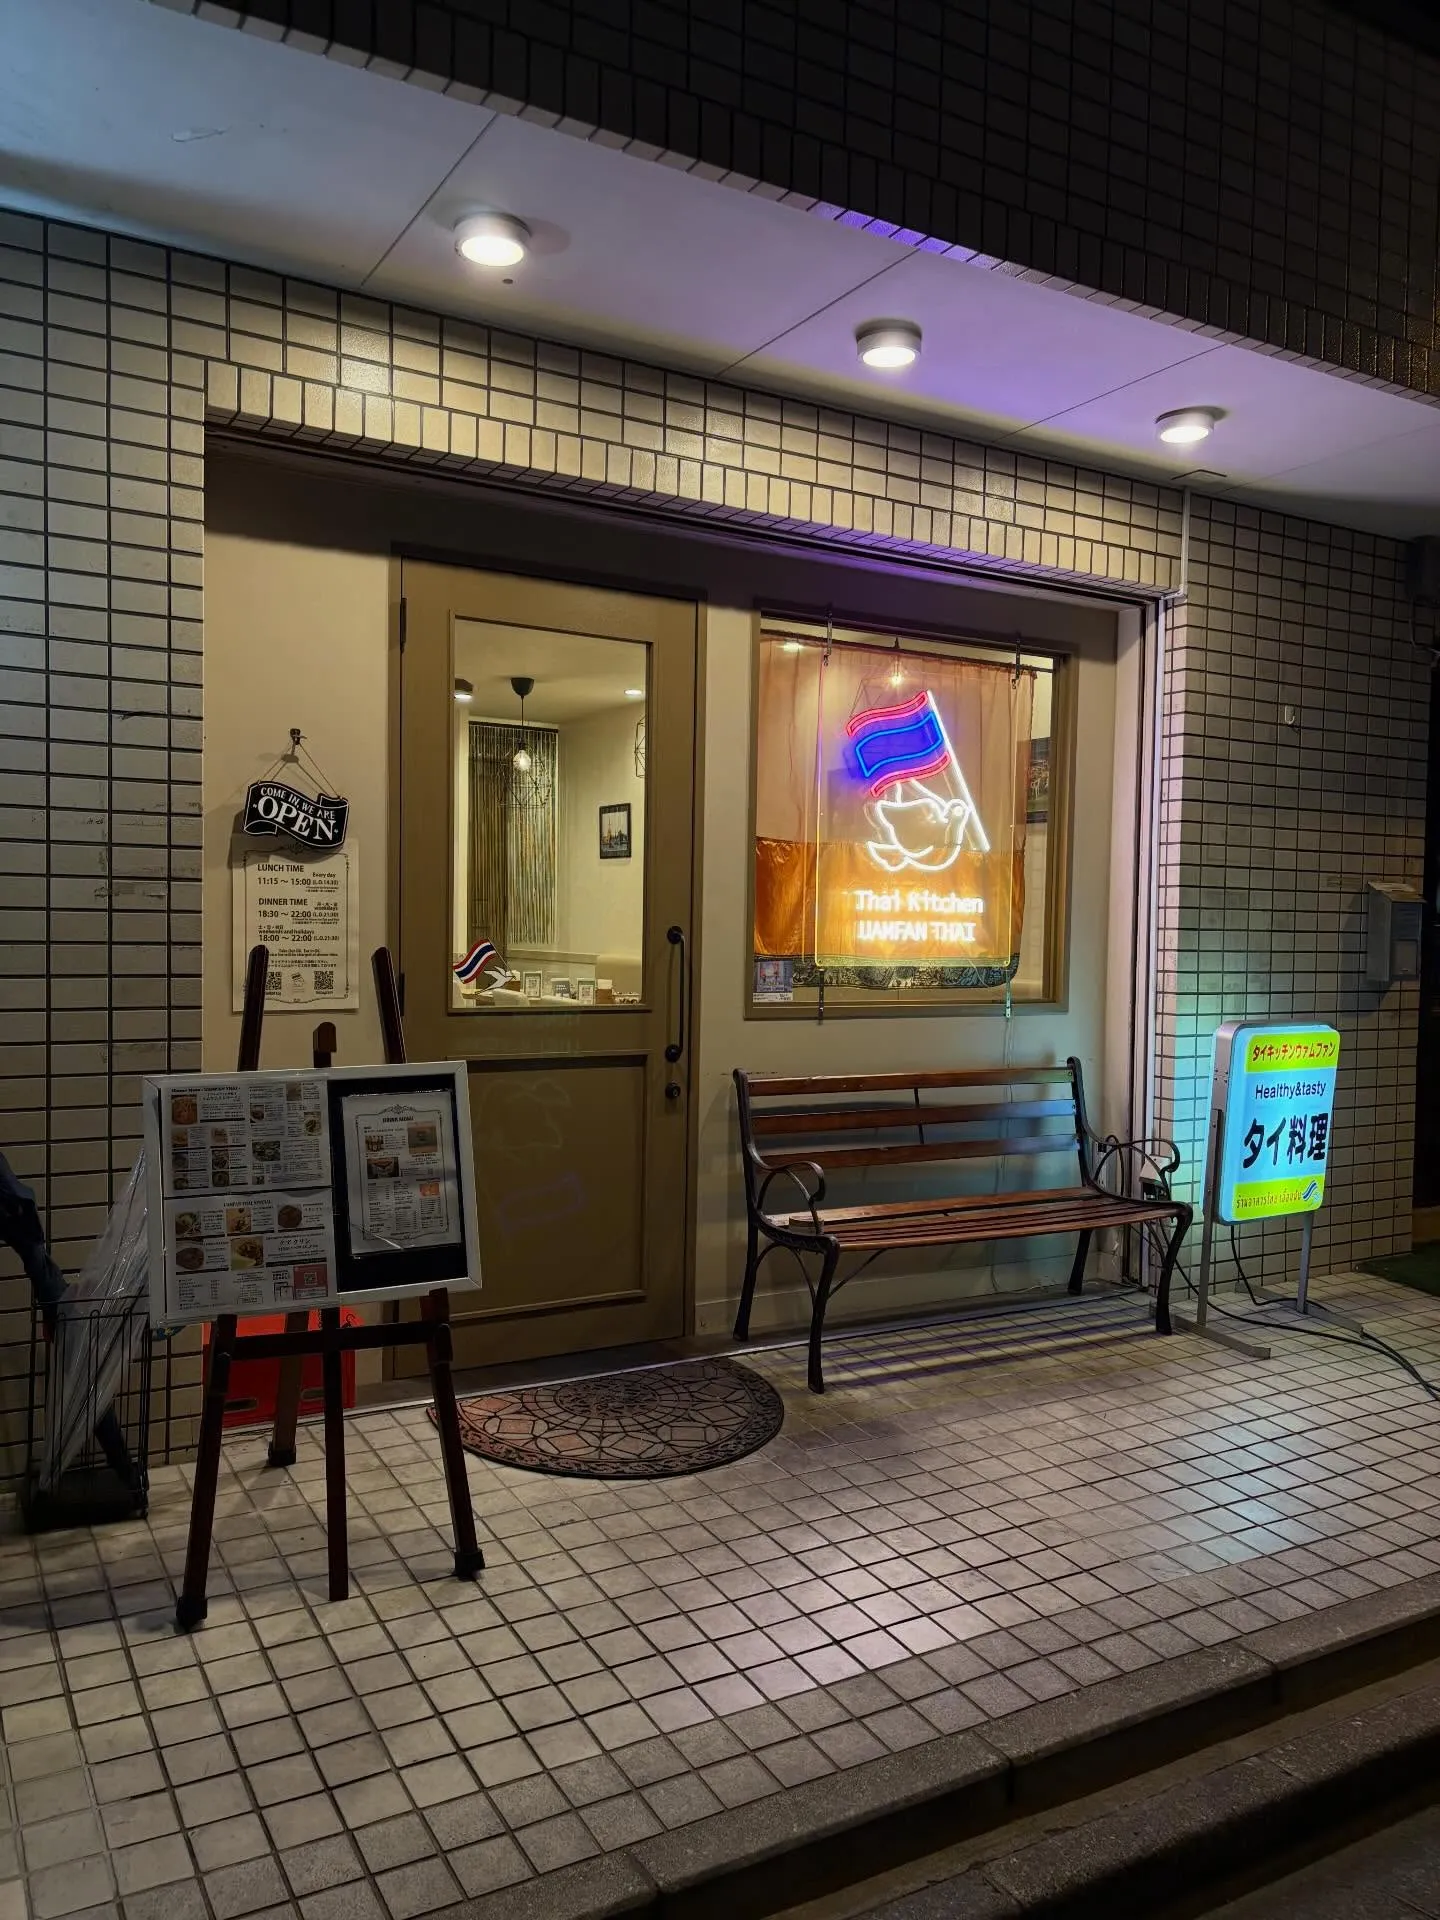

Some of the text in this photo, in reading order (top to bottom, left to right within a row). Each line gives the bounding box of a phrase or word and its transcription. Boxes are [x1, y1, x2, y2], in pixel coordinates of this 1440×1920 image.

[260, 787, 336, 820] COME IN, WE ARE
[257, 795, 337, 841] OPEN
[257, 864, 284, 872] LUNCH
[257, 877, 279, 885] 11:15
[258, 897, 308, 906] DINNER TIME
[854, 889, 985, 914] Thai Kitchen
[929, 921, 976, 942] THAI
[1255, 1081, 1327, 1100] Healthy&tasty
[1243, 1113, 1329, 1169] タイ料理
